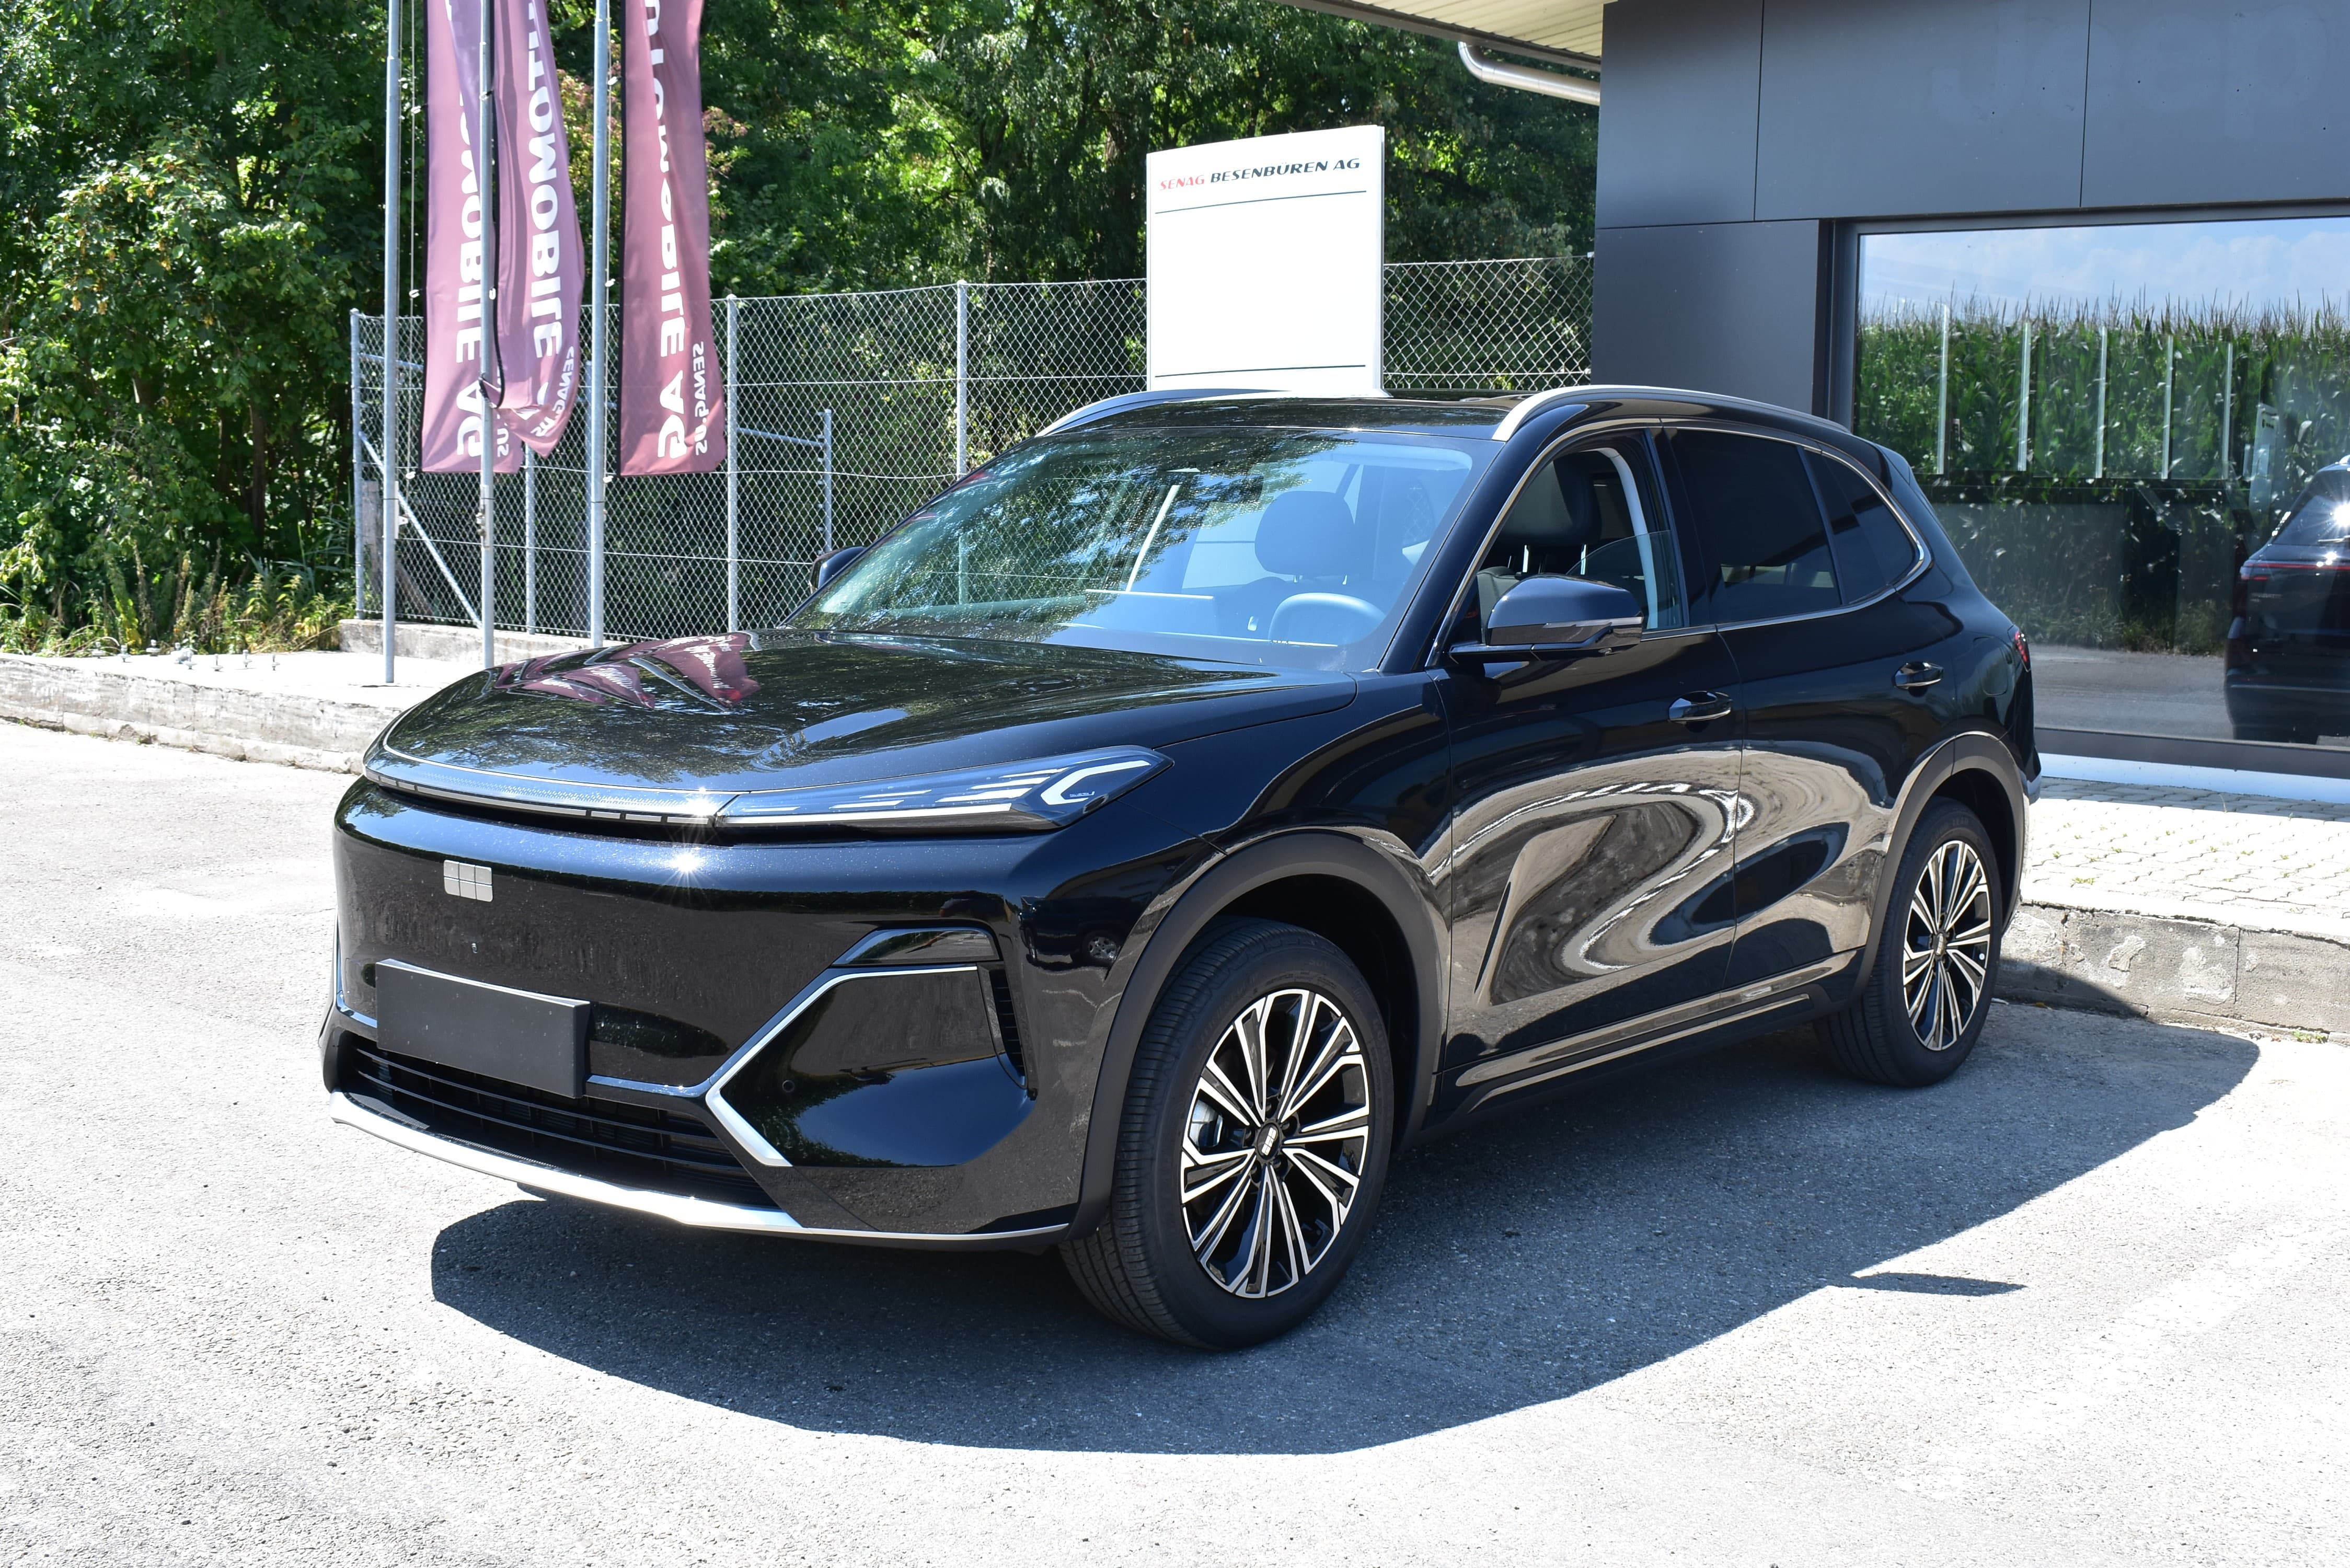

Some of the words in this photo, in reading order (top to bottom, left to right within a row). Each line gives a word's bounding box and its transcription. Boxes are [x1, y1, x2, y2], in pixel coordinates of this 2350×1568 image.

[1159, 175, 1205, 191] SENAG
[1210, 160, 1329, 183] BESENBÜREN
[1333, 158, 1360, 170] AG
